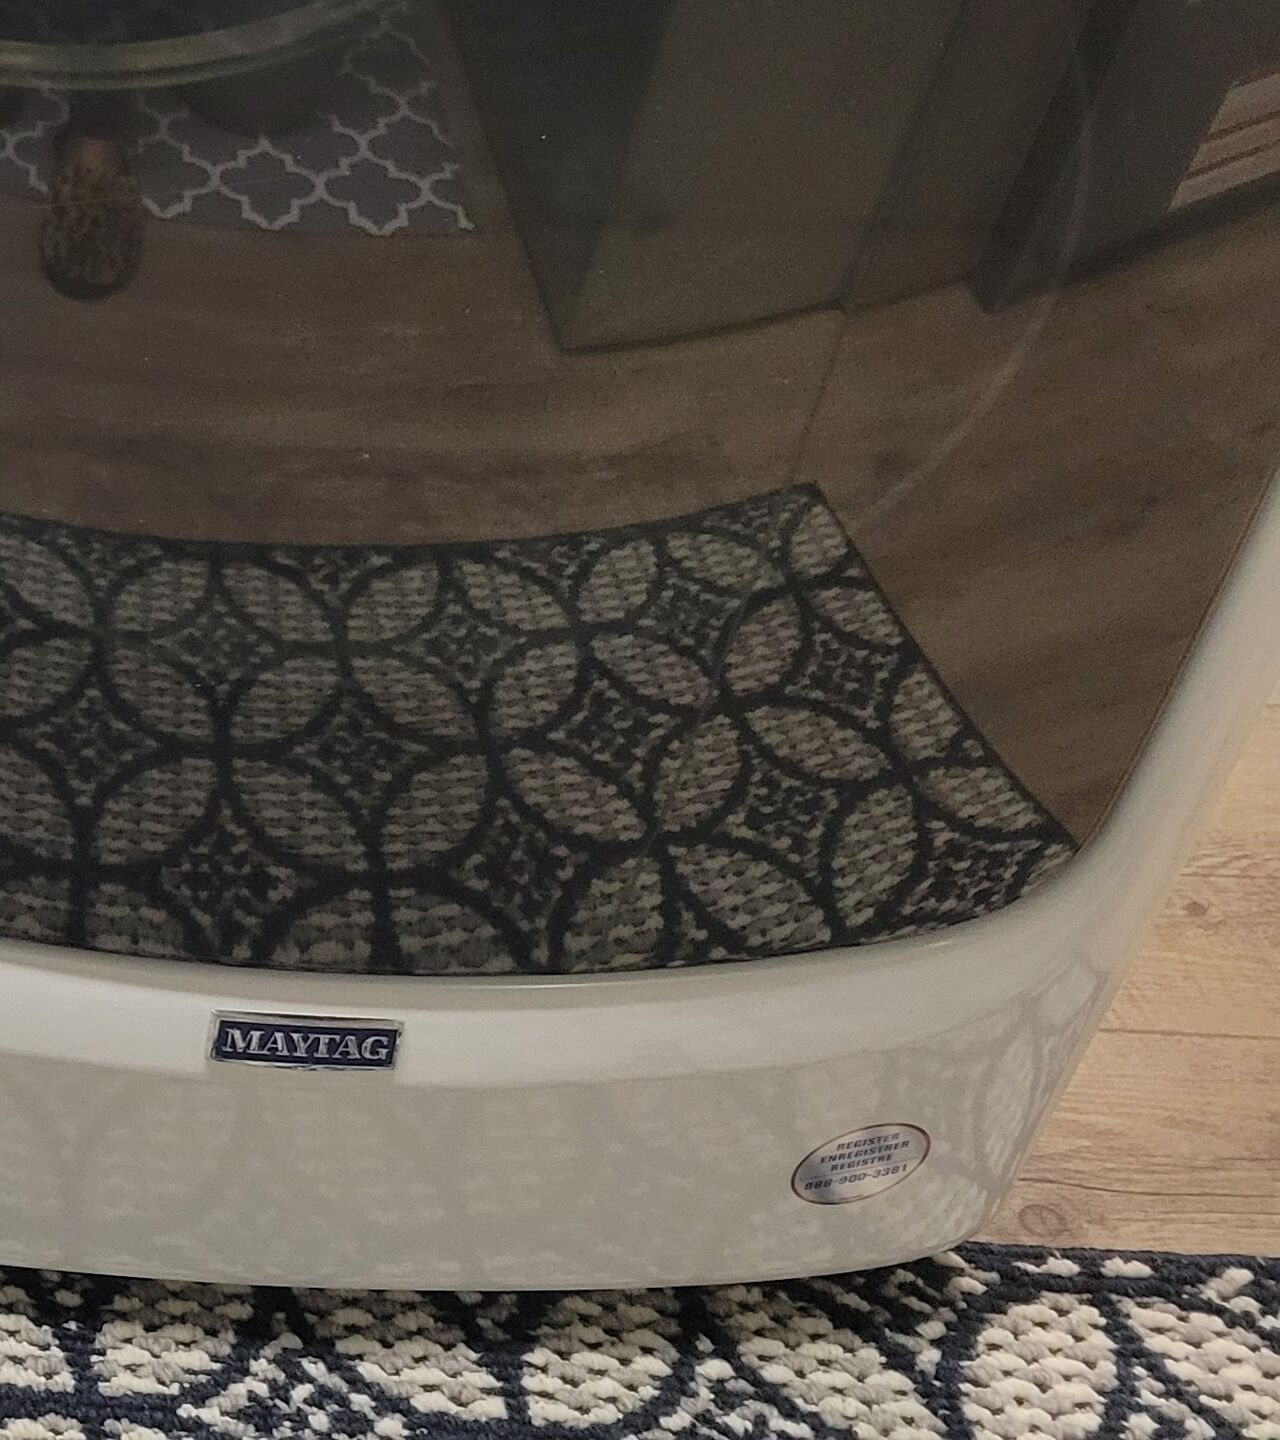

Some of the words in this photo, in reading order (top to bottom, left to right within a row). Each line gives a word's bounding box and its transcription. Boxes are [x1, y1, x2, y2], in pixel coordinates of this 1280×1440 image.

[222, 1027, 390, 1060] MAYTAG
[820, 1140, 910, 1164] ENREGISTRER
[836, 1133, 900, 1151] REGISTER
